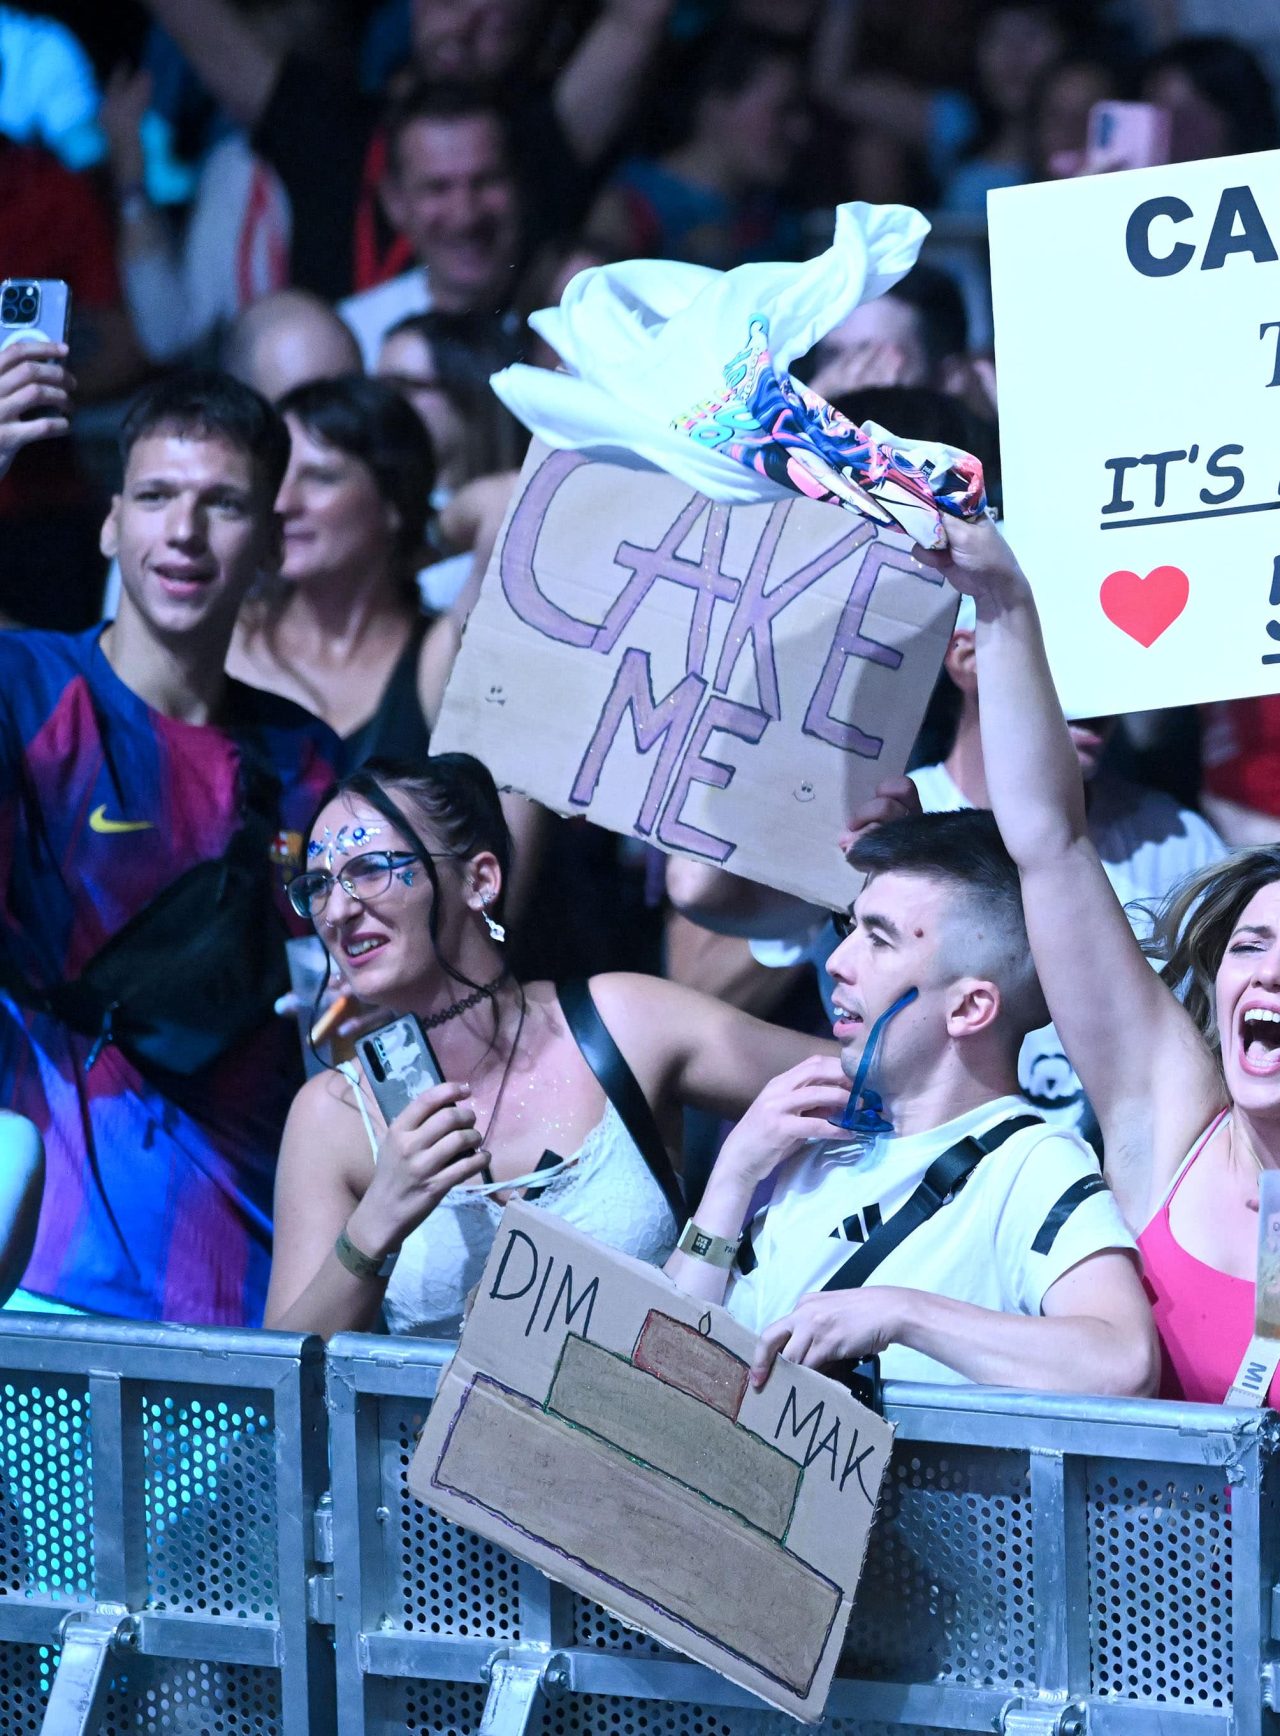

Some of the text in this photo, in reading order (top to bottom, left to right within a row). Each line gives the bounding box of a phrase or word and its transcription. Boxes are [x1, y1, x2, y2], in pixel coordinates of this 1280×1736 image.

[1101, 444, 1245, 514] IT'S
[500, 448, 947, 760] CAKE
[568, 647, 774, 863] ME
[490, 1230, 600, 1338] DIM
[773, 1386, 876, 1506] MAK
